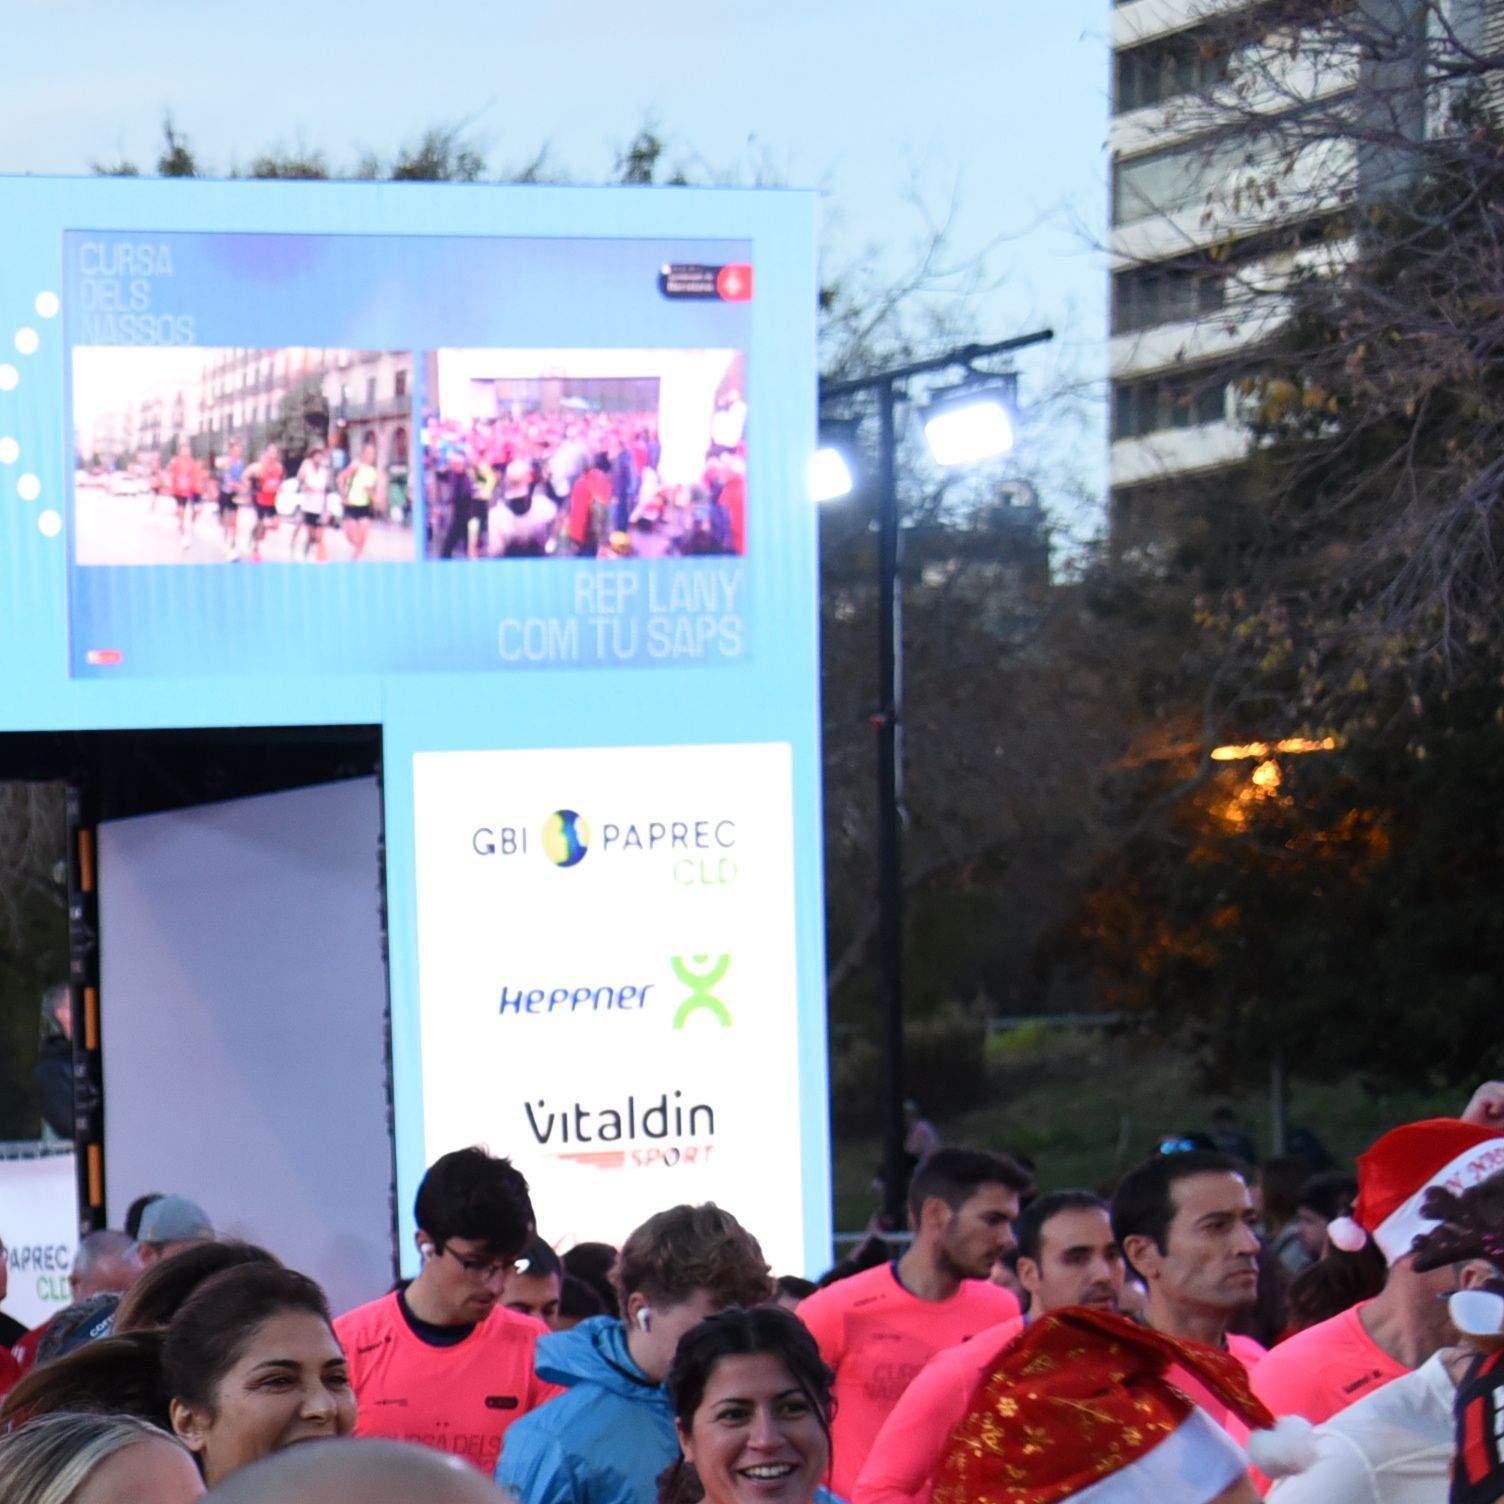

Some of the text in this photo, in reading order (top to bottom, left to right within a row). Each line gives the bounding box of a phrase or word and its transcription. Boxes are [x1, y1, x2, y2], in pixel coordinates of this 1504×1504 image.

[80, 241, 176, 277] CURSA
[80, 278, 152, 312] DELS
[573, 569, 741, 615] REP LANY
[498, 614, 744, 661] COM TU SAPS
[472, 819, 737, 856] GBI PAPREC
[673, 857, 738, 886] CLD
[524, 1090, 716, 1145] Vitaldin
[630, 1144, 716, 1168] SPORT
